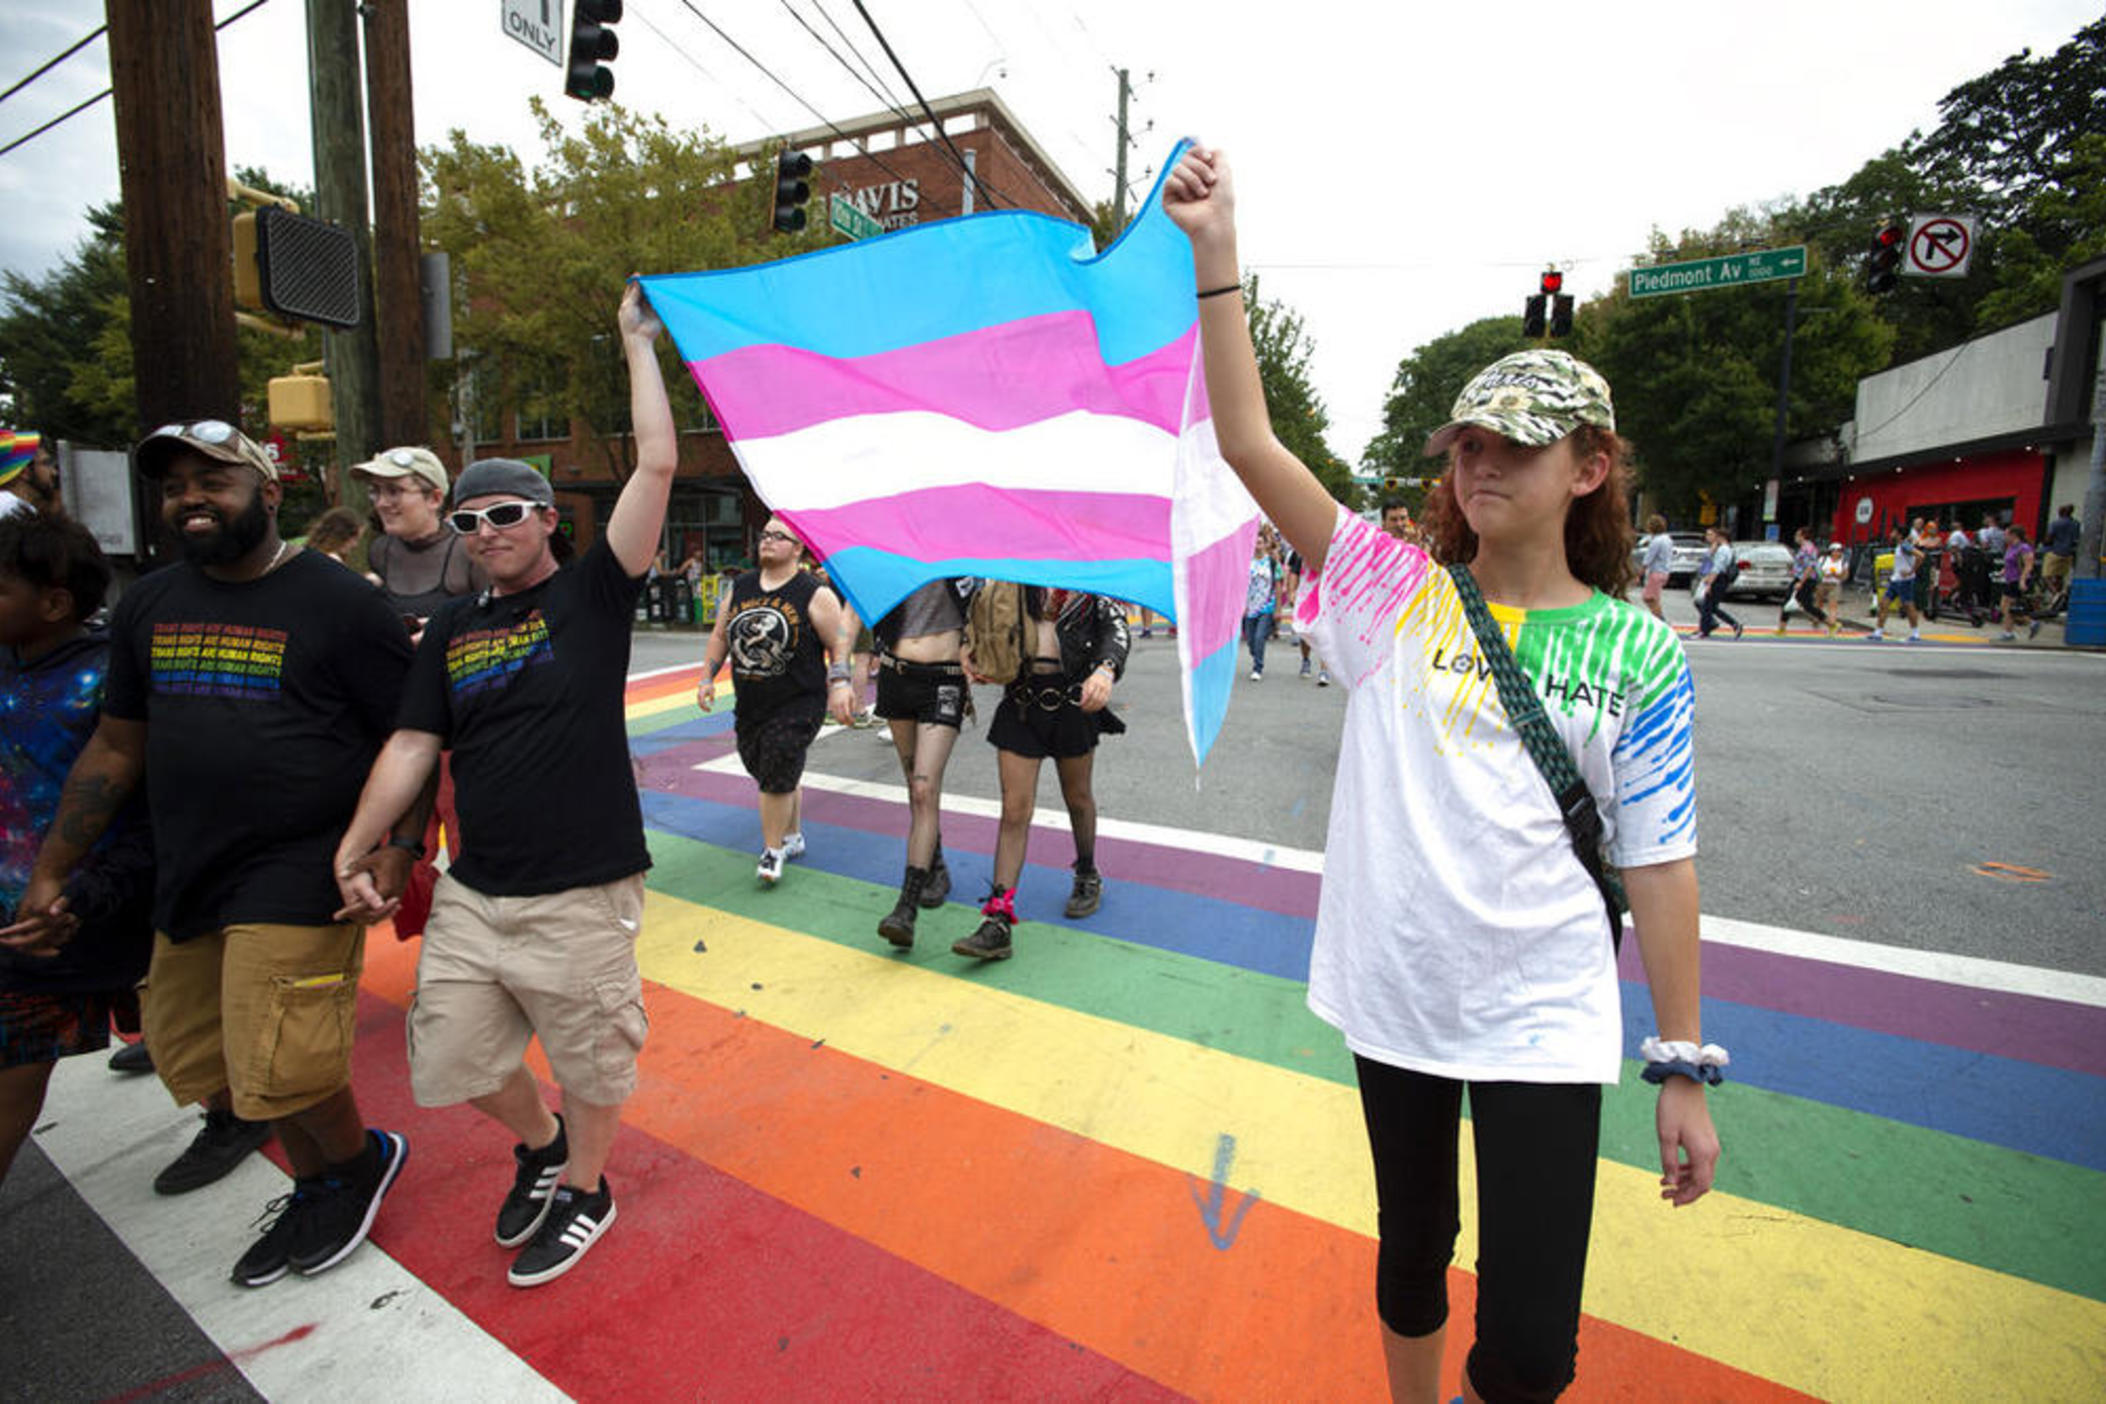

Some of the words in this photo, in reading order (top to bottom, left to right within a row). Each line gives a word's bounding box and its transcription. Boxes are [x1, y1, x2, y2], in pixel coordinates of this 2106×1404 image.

[509, 11, 556, 52] ONLY
[1634, 265, 1712, 292] Piedmont
[1719, 261, 1742, 281] Av
[1432, 649, 1493, 683] LOV
[1544, 673, 1625, 718] HATE
